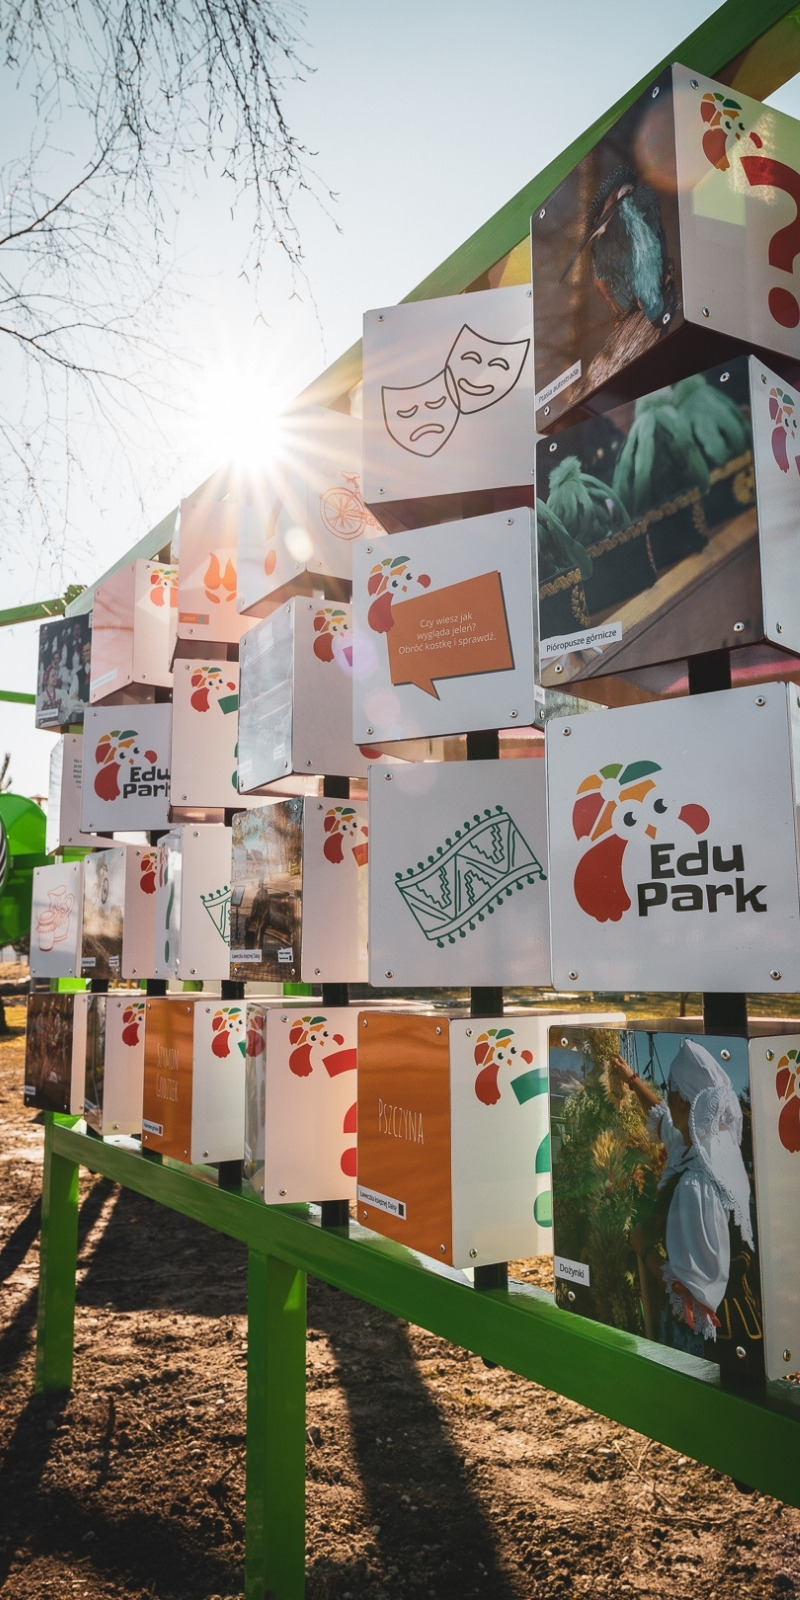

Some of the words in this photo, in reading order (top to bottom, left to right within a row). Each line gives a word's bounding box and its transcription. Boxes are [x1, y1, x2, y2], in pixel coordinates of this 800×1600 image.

[417, 628, 450, 641] wygląda
[452, 622, 476, 637] jeleń?
[420, 619, 434, 629] Czy
[436, 615, 458, 625] wiesz
[460, 611, 473, 623] jak
[398, 642, 423, 655] Obróć
[425, 640, 452, 651] kostkę
[458, 632, 497, 647] sprawdź.
[546, 635, 585, 652] Pióropusze
[586, 629, 617, 644] górnicze
[130, 766, 171, 783] Edu
[650, 839, 745, 880] Edu
[637, 877, 768, 917] Park
[378, 1098, 425, 1145] PSZCZYNA
[559, 1263, 585, 1279] Dożynki
